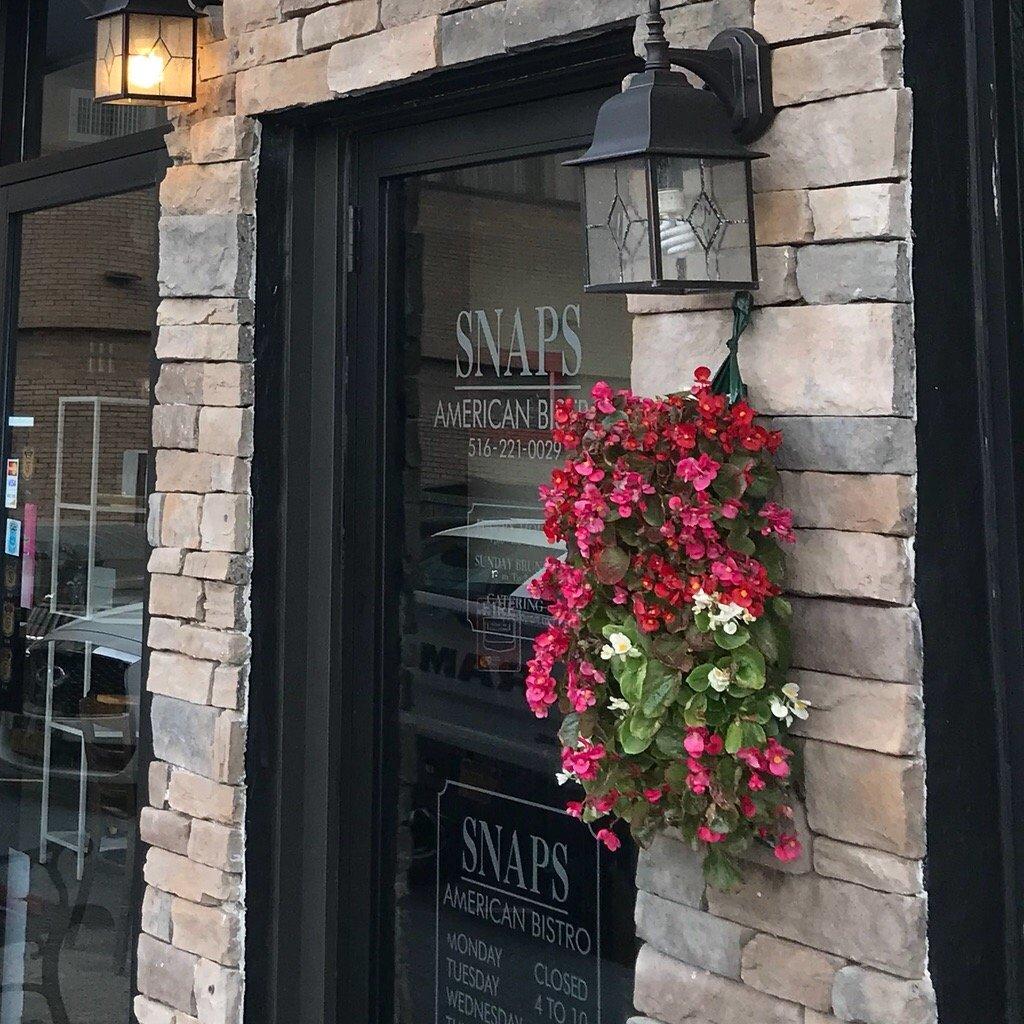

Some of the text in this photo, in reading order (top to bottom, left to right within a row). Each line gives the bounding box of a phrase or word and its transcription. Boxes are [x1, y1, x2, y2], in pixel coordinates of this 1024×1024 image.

[456, 304, 582, 378] SNAPS
[434, 399, 530, 429] AMERICAN
[468, 438, 562, 460] 516-221-0029
[475, 555, 512, 572] SUNDAY
[487, 593, 544, 613] CATERING
[462, 816, 569, 903] SNAPS
[443, 883, 591, 955] AMERICAN BISTRO
[446, 957, 501, 997] TUESDAY
[534, 995, 544, 1014] 4
[546, 997, 566, 1023] TO
[447, 933, 588, 1001] MONDAY CLOSED
